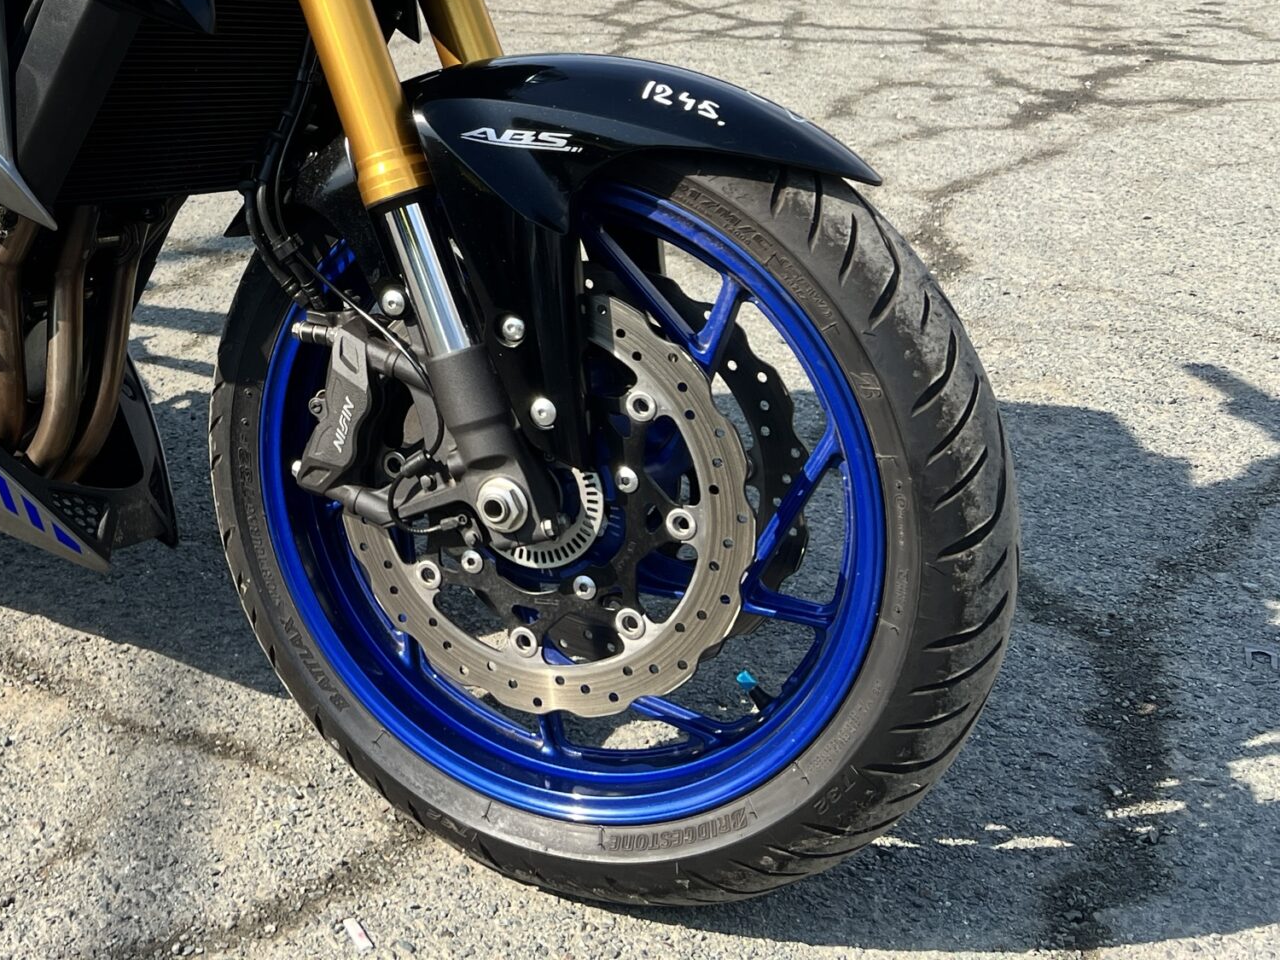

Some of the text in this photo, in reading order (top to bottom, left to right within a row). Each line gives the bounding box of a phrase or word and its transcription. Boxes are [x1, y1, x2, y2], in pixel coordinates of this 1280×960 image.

[461, 127, 577, 151] ABS
[332, 395, 356, 454] NISSIN
[283, 617, 350, 712] BATTLAX
[813, 777, 856, 815] T32
[609, 807, 748, 852] BRIDGESTONE
